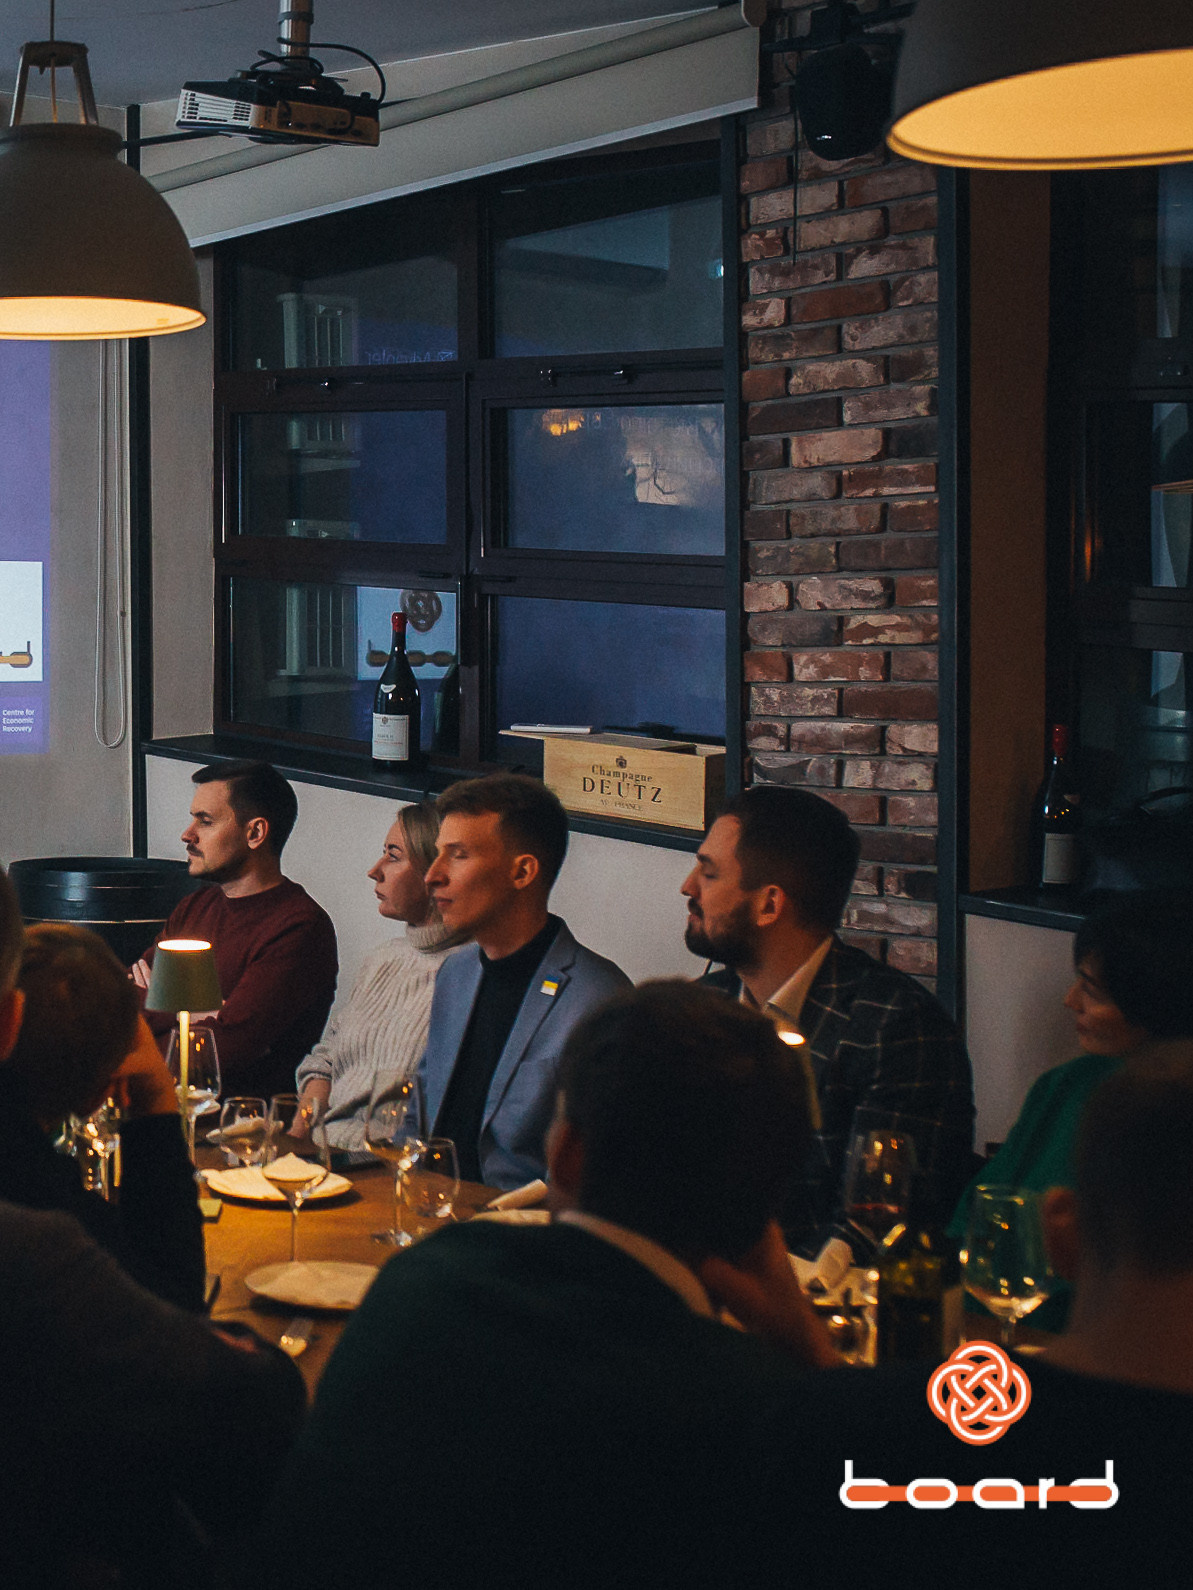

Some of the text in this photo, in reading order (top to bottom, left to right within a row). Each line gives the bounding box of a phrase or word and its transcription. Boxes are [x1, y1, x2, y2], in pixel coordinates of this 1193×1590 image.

[25, 708, 35, 716] for
[2, 717, 35, 725] Economic
[2, 725, 33, 733] Recovery
[591, 764, 653, 783] Champagne
[582, 776, 662, 803] DEUTZ
